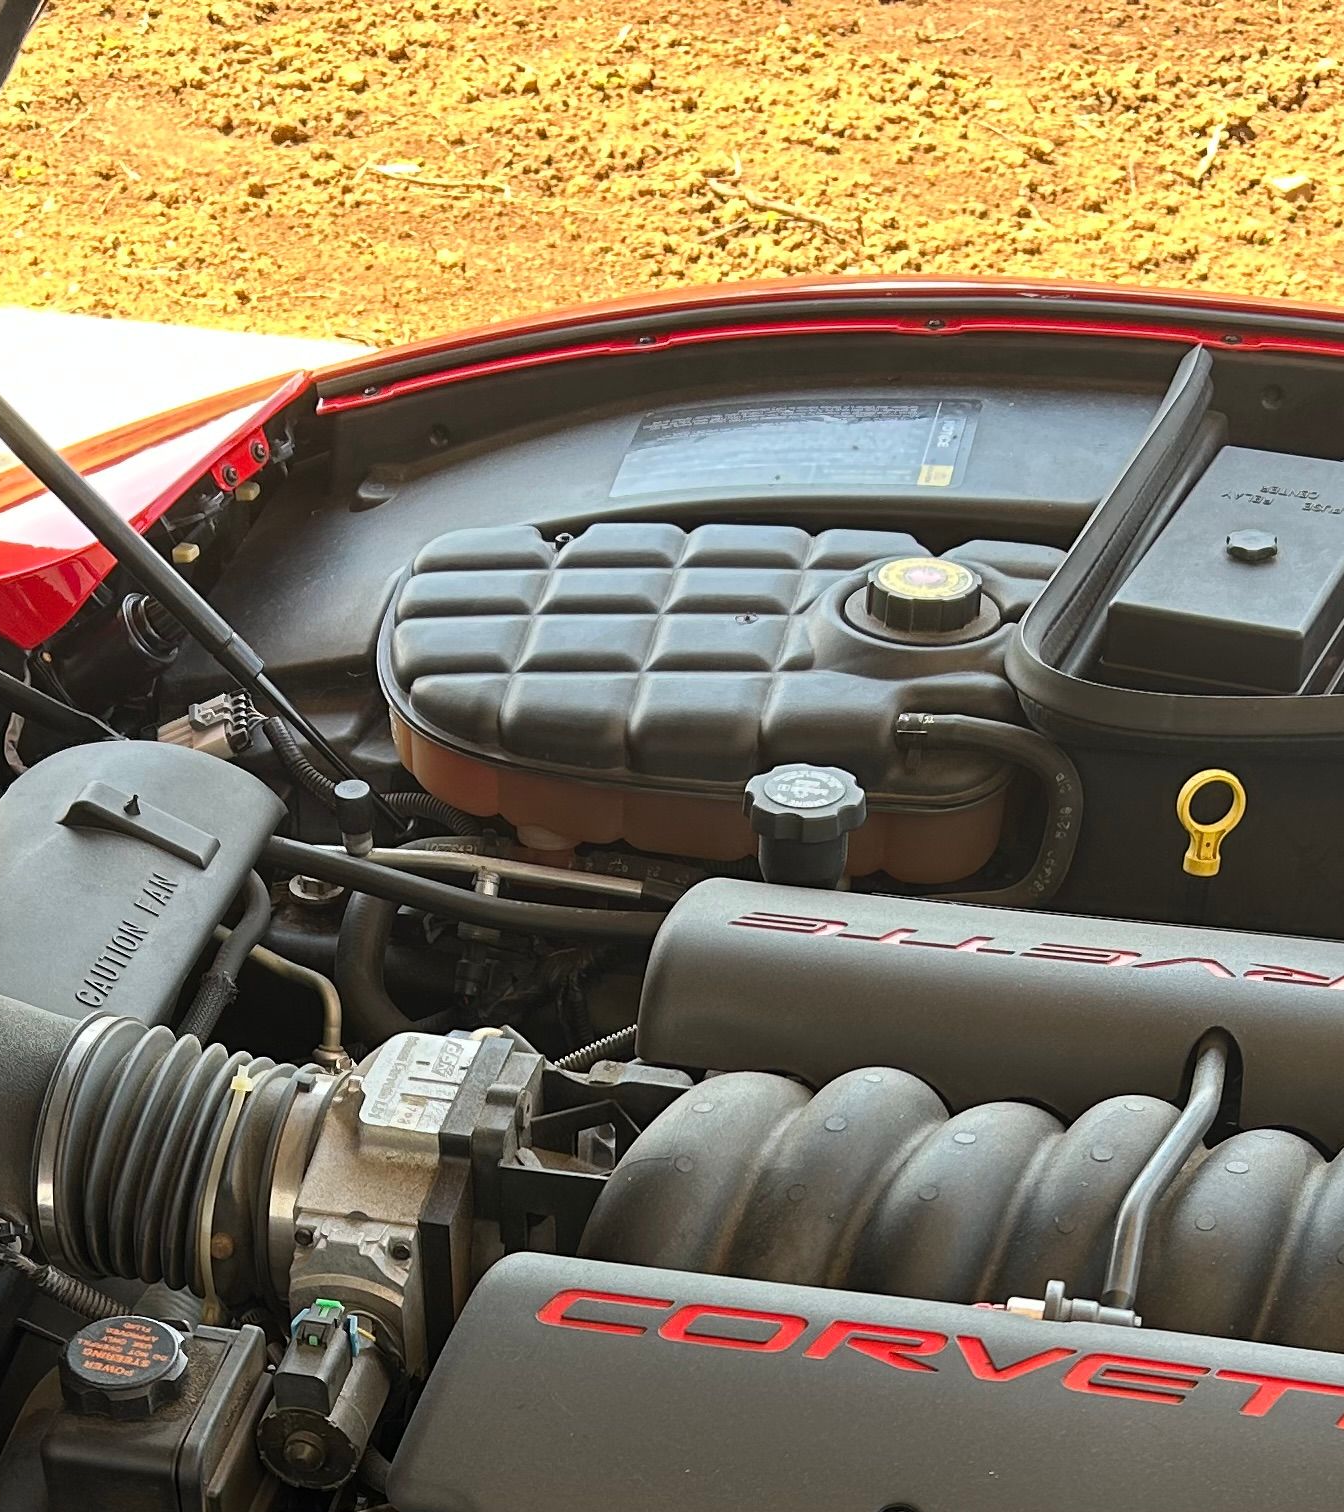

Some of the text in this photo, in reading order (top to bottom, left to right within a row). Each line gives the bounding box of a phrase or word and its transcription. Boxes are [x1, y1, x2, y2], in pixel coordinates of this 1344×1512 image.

[1260, 485, 1320, 500] CENTER
[1221, 491, 1344, 514] FUSE RELAY
[76, 873, 179, 1007] CAUTION FAN
[82, 1347, 151, 1368] STEERING
[127, 1348, 149, 1359] NOT
[83, 1360, 134, 1377] POWER
